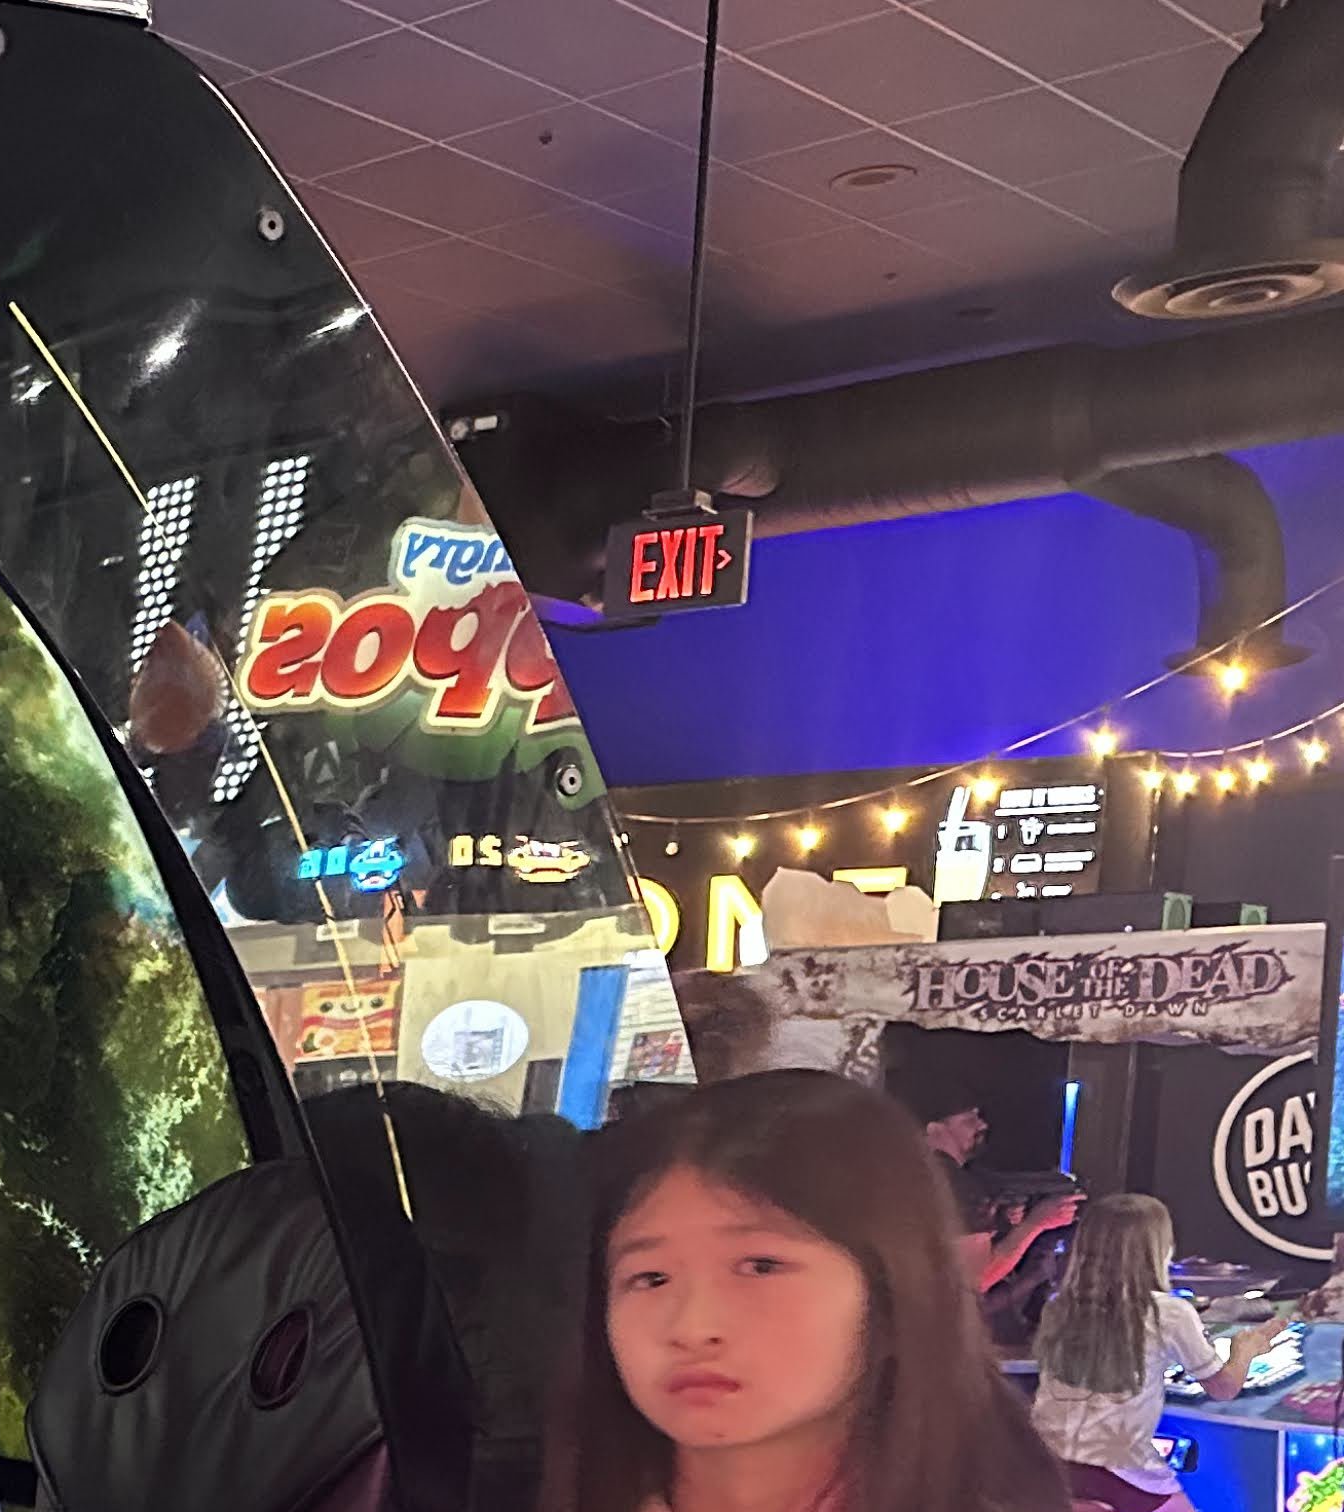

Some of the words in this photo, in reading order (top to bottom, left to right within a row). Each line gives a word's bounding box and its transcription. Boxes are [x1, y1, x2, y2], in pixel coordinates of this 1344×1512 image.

[630, 524, 724, 602] EXIT
[915, 960, 1075, 1010] HOUSE
[1080, 976, 1130, 999] THE
[1090, 960, 1126, 979] OF
[1139, 951, 1286, 1002] DEAD
[977, 1004, 1102, 1021] SCARLET
[1123, 1002, 1210, 1019] DAWN
[1244, 1091, 1315, 1169] DA
[1246, 1161, 1311, 1218] BU
